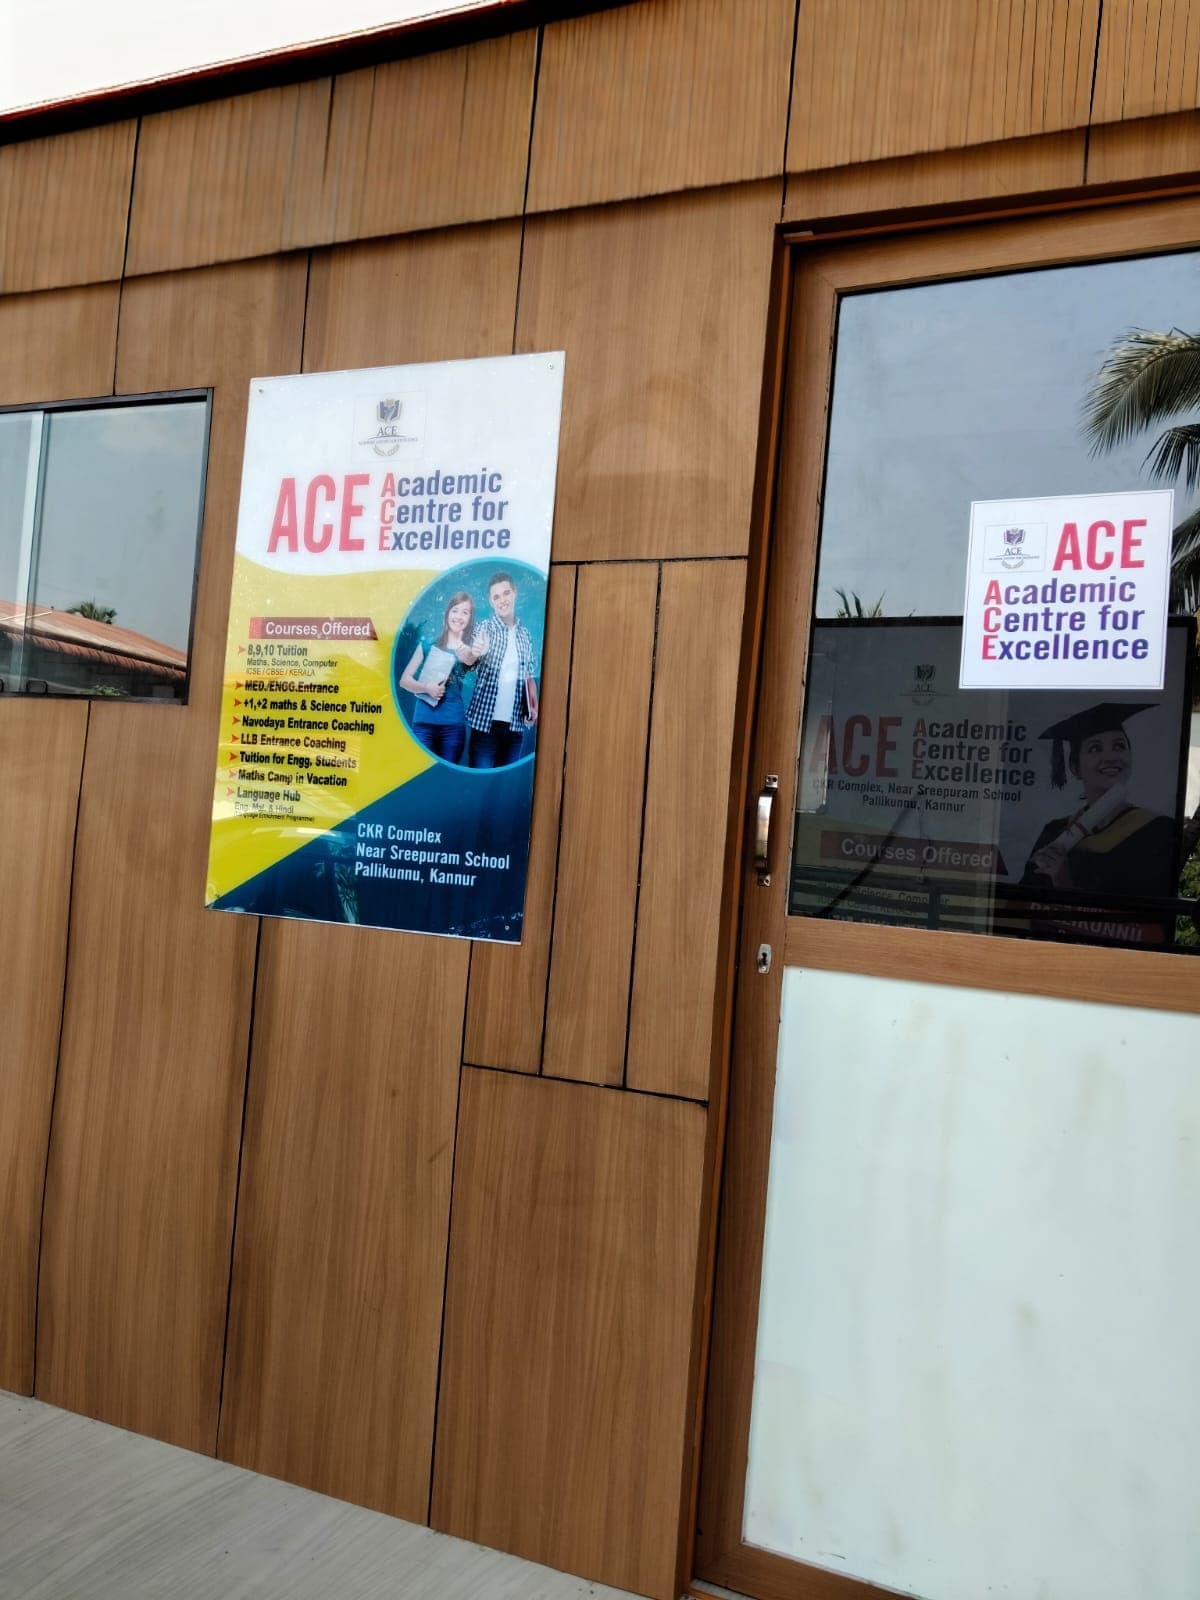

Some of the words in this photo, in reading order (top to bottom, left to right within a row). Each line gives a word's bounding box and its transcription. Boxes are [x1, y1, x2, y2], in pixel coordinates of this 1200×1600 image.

[377, 425, 397, 436] ACE
[380, 467, 503, 498] Academic
[267, 474, 370, 553] ACE
[380, 498, 461, 524] Centre
[472, 496, 509, 522] for
[378, 524, 511, 551] Excellence
[1052, 519, 1148, 571] ACE
[983, 576, 1137, 605] Academic
[266, 621, 317, 635] Courses
[322, 622, 370, 636] Offered
[983, 606, 1086, 632] Centre
[1098, 605, 1146, 631] for
[247, 644, 275, 657] 8,9,10
[277, 645, 308, 656] Tuition
[982, 633, 1149, 660] Excellence
[303, 659, 338, 669] Computer
[270, 699, 298, 711] maths
[300, 700, 307, 711] &
[310, 700, 347, 713] Science
[350, 701, 382, 714] Tuition
[242, 715, 285, 730] Navodaya
[287, 717, 328, 731] Entrance
[332, 719, 375, 735] Coaching
[912, 718, 1027, 741] Academic
[241, 733, 258, 745] LLB
[260, 734, 301, 747] Entrance
[304, 736, 347, 752] Coaching
[809, 714, 903, 778] ACE
[912, 737, 990, 762] Centre
[1000, 741, 1033, 764] for
[240, 751, 270, 763] Tuition
[273, 752, 285, 764] for
[287, 753, 313, 769] Engg.
[315, 755, 357, 769] Students
[238, 769, 265, 781] Maths
[267, 771, 293, 785] Camp
[295, 772, 304, 784] in
[306, 773, 347, 787] Vacation
[911, 760, 1036, 786] Excellence
[237, 786, 281, 803] Language
[283, 789, 301, 802] Hub
[888, 782, 913, 795] Near
[917, 784, 979, 802] Sreepuram
[982, 788, 1022, 803] School
[925, 798, 966, 813] Kannur
[357, 823, 384, 839] CKR
[387, 825, 442, 845] Complex
[356, 842, 386, 859] Near
[390, 845, 460, 865] Sreepuram
[464, 851, 510, 870] School
[841, 838, 917, 862] Courses
[922, 845, 994, 869] Offered
[355, 862, 424, 884] Pallikunnu,
[429, 868, 477, 887] Kannur
